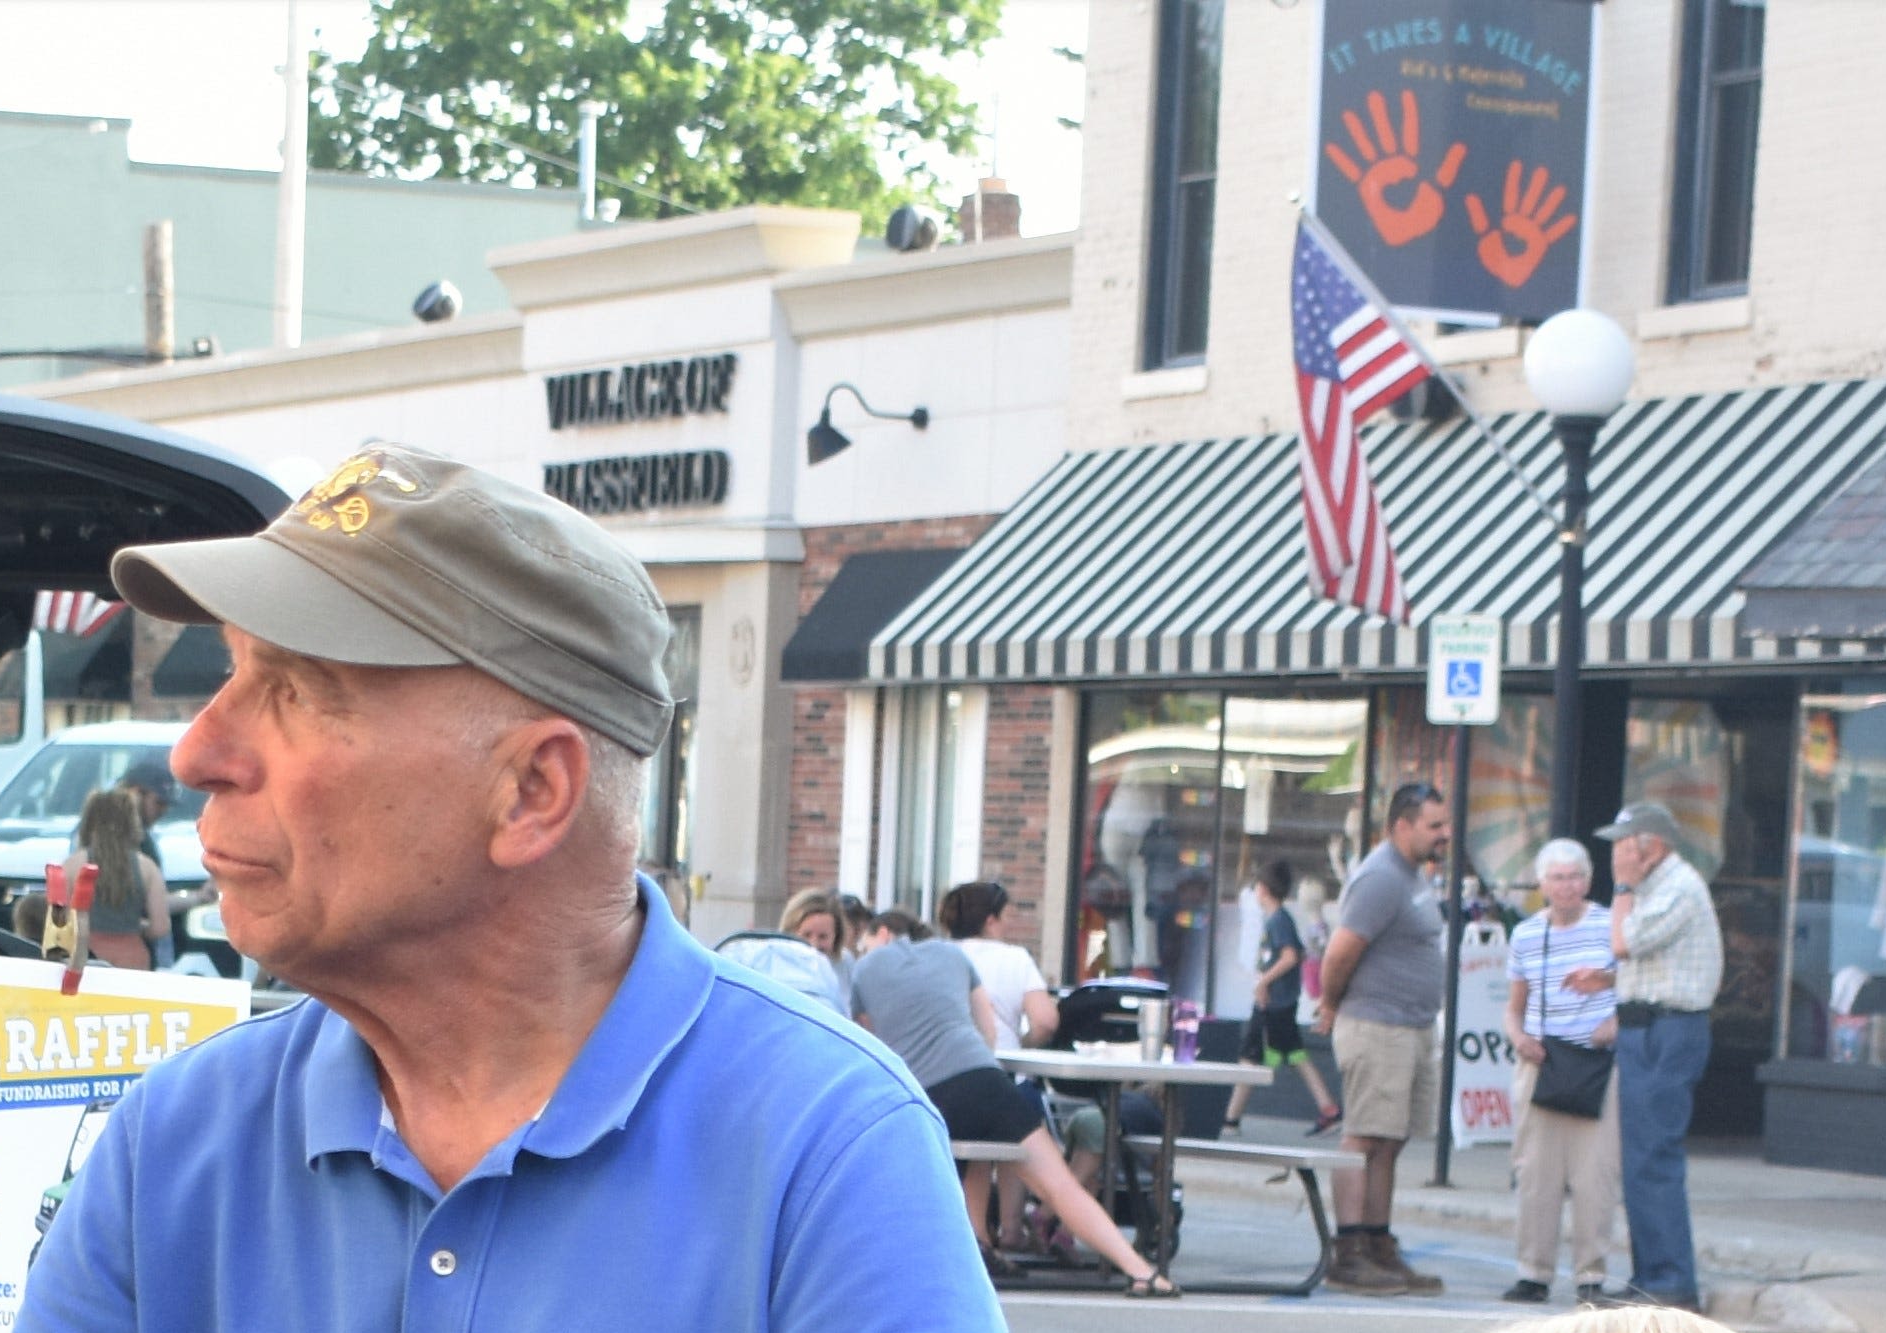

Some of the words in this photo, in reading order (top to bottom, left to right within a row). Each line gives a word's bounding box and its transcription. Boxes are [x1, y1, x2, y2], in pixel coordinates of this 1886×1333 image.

[1328, 42, 1355, 74] IT
[1366, 17, 1443, 54] TAKES
[1454, 24, 1471, 43] A
[1484, 25, 1582, 95] VILLAGE
[545, 361, 683, 430] VILLAGE
[5, 1011, 191, 1074] RAFFLE
[94, 1082, 120, 1098] FOR
